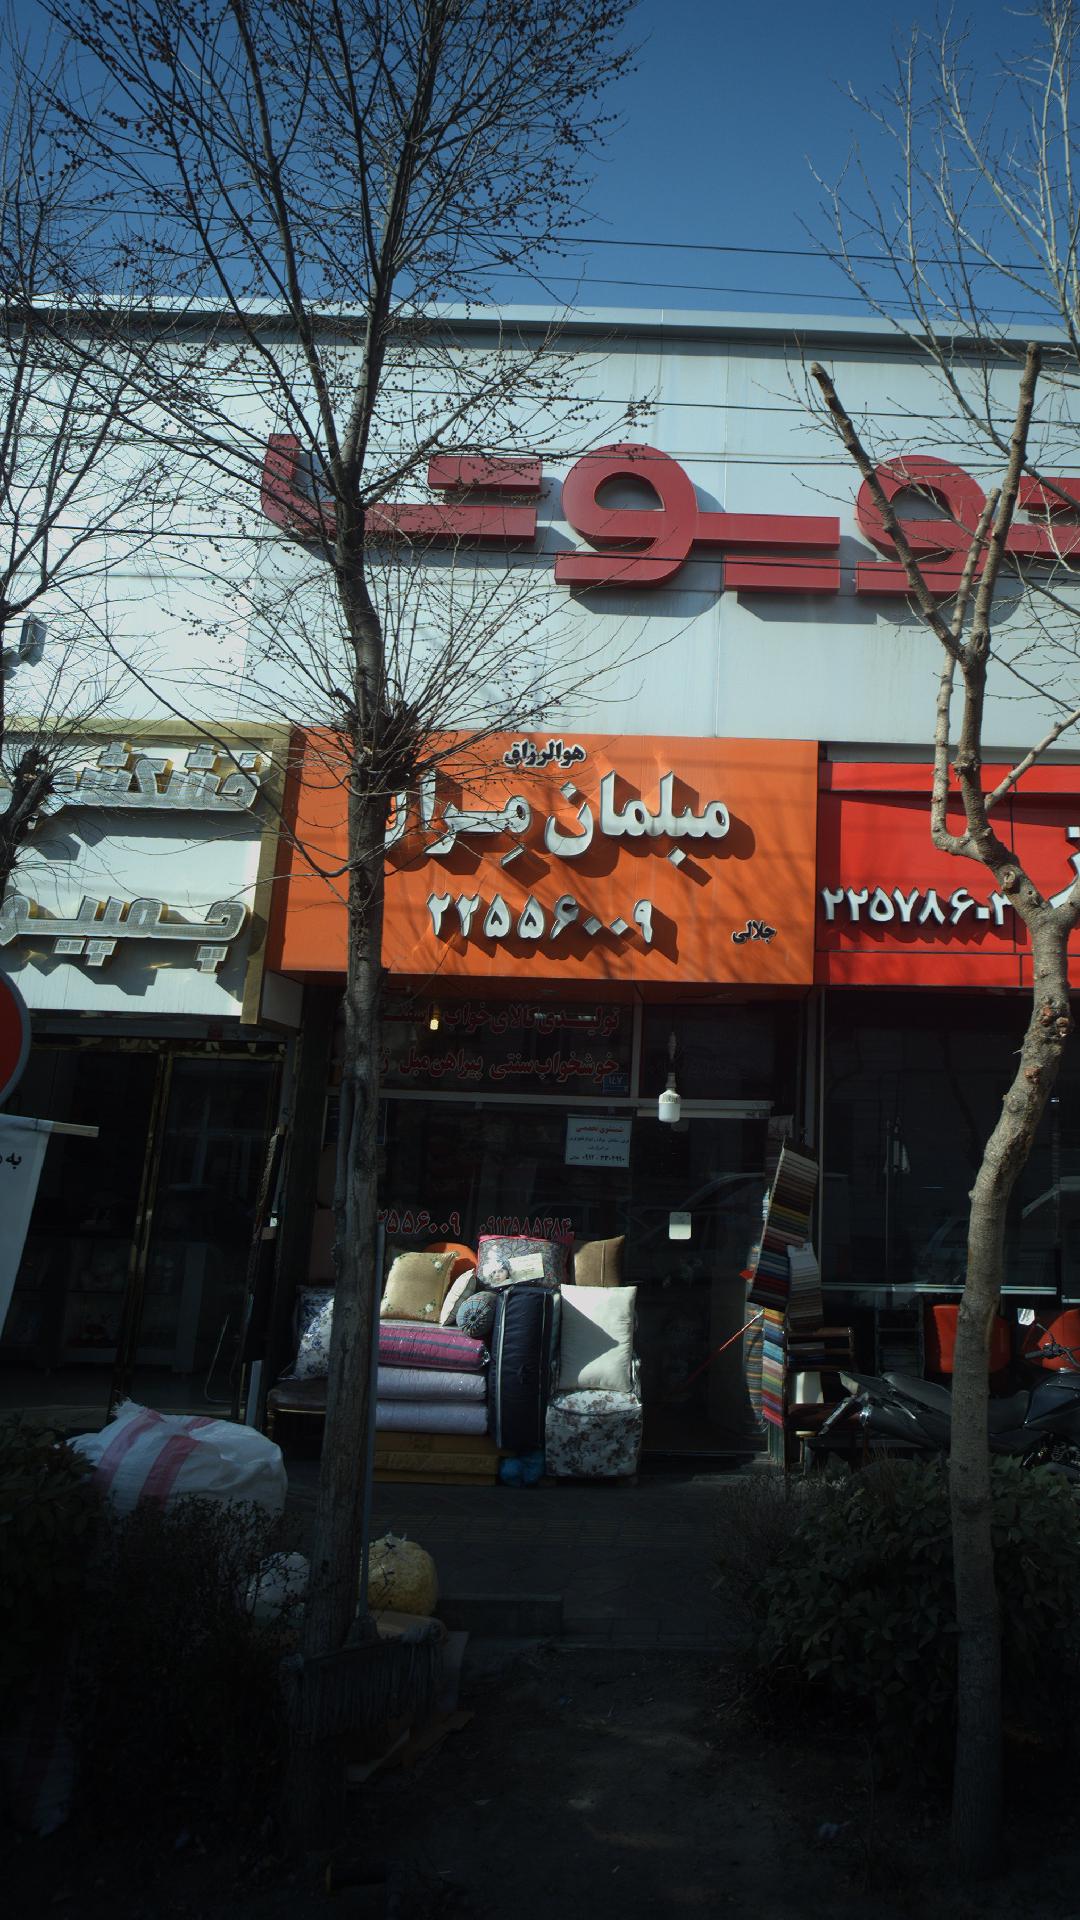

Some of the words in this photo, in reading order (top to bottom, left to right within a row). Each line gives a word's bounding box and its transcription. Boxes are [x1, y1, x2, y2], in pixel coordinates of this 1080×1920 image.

[503, 738, 587, 768] هوالرزاق
[544, 770, 730, 866] مبلمان
[427, 892, 653, 944] ۲۲۵۵۶۰۰۹
[732, 919, 777, 944] جلالی
[443, 1001, 491, 1033] خواب
